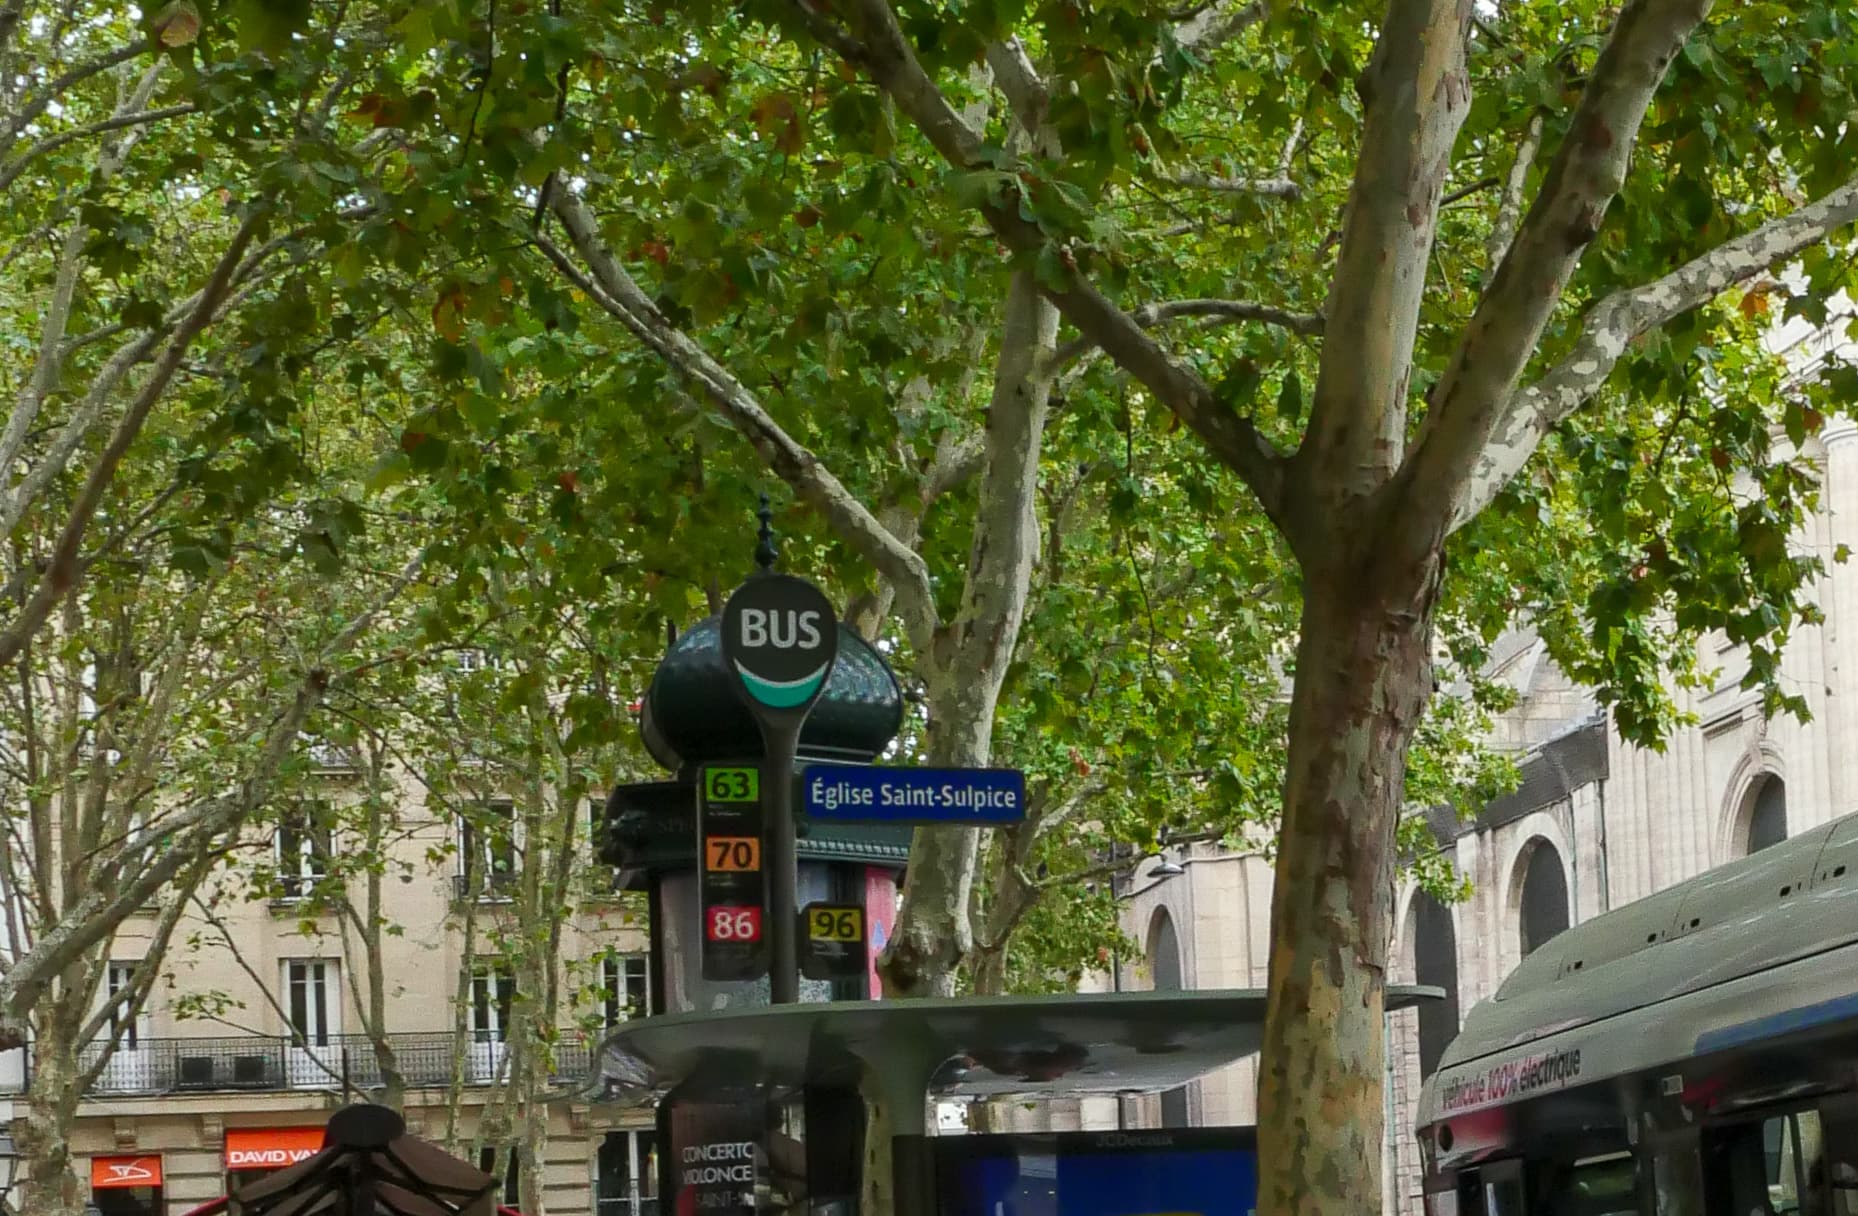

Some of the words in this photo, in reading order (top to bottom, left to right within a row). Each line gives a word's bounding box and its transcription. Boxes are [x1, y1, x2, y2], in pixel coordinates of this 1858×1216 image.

[740, 608, 821, 649] BUS
[712, 772, 750, 799] 63
[812, 778, 873, 807] Église
[880, 783, 1016, 811] Saint-Sulpice
[712, 841, 752, 868] 70
[713, 912, 753, 939] 86
[815, 912, 855, 939] 96
[1443, 1075, 1486, 1110] véhicule
[1487, 1060, 1519, 1101] 100%
[1519, 1047, 1581, 1092] électrique
[230, 1150, 286, 1163] DAVID
